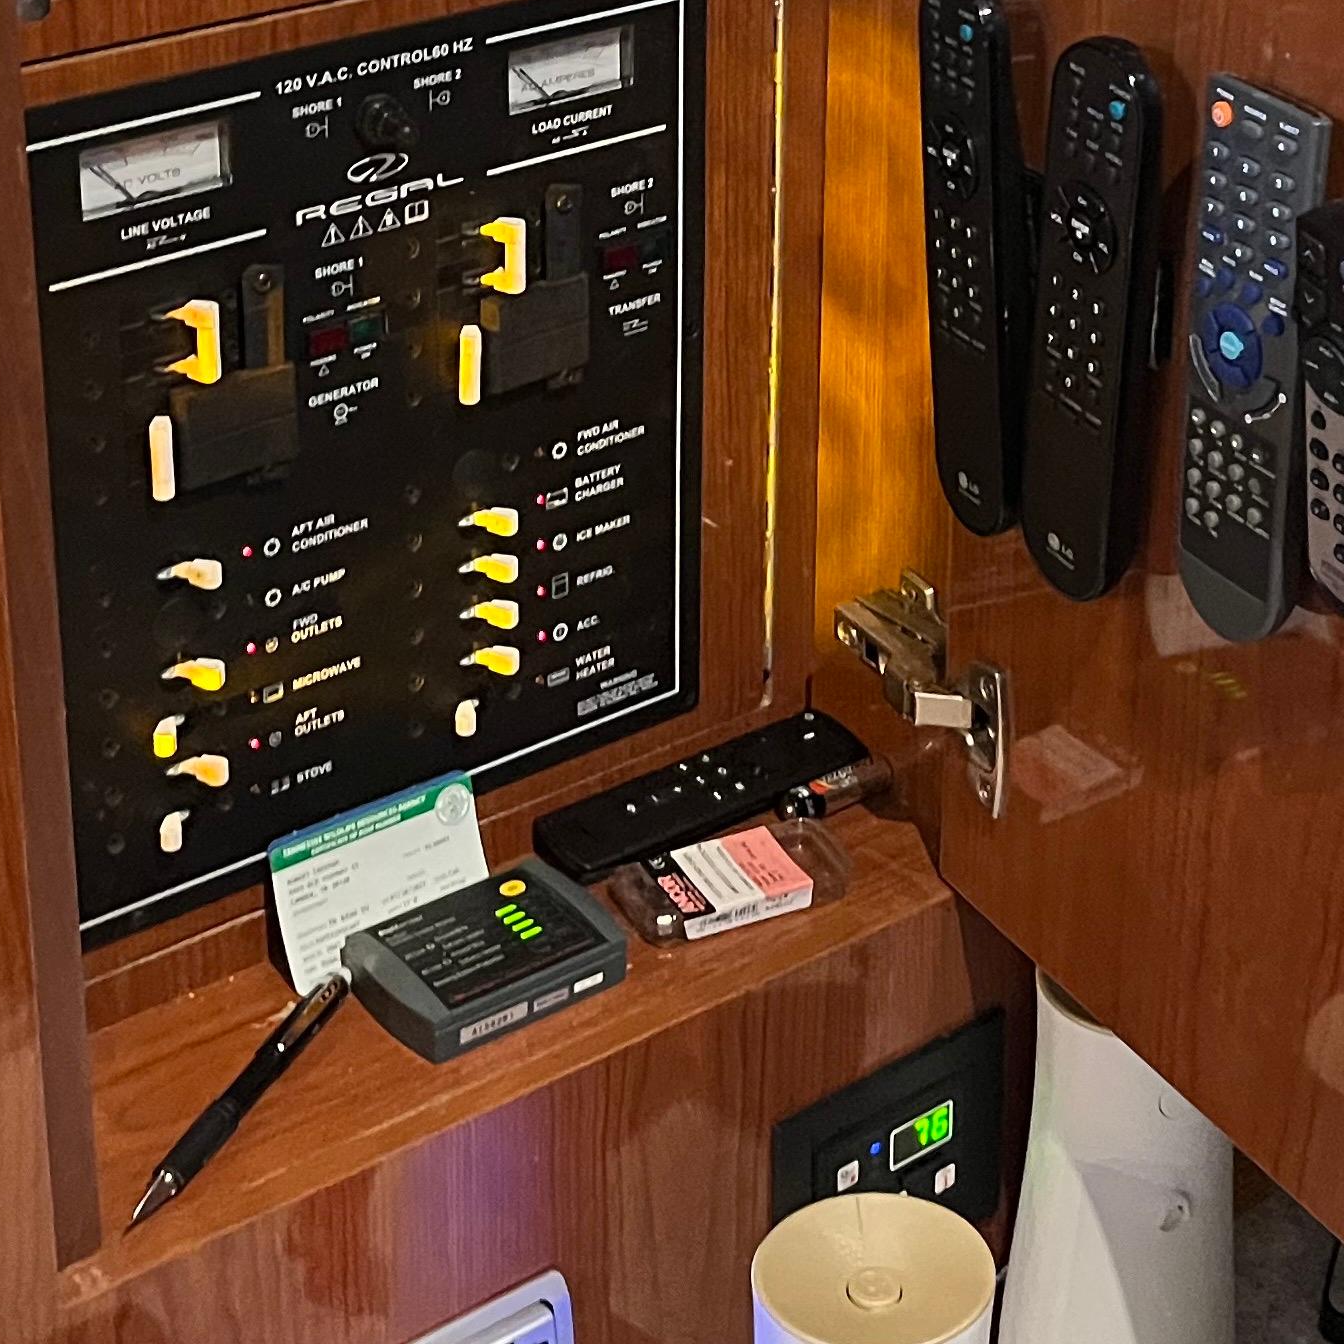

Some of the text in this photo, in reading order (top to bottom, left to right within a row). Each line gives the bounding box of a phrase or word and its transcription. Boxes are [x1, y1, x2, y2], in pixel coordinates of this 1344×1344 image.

[275, 77, 302, 96] 120
[305, 66, 353, 88] V.A.C.
[452, 37, 474, 54] HZ
[413, 68, 462, 90] SHORE 2
[292, 96, 342, 119] SHORE 1
[532, 104, 613, 135] LOAD CURRENT
[138, 167, 181, 186] VOLTS
[610, 179, 646, 198] SHORE
[295, 173, 464, 226] REGAL
[121, 206, 211, 241] LINE VOLTAGE
[315, 256, 363, 279] SHORE 1
[609, 293, 661, 316] TRANSFER
[308, 377, 379, 407] GENERATOR
[577, 419, 619, 442] FWD AIR
[577, 424, 645, 456] CONDITIONER
[575, 463, 622, 488] BATTERY
[575, 477, 624, 502] CHARGER
[291, 514, 335, 537] AFT AIR
[292, 518, 369, 553] CONDITIONER
[576, 514, 631, 543] ICE MAKER
[291, 568, 346, 596] A/C PUMP
[576, 565, 616, 587] REFRIG.
[291, 615, 343, 644] OUTLETS
[293, 613, 318, 631] FWD
[575, 645, 611, 667] WATER
[576, 657, 615, 680] HEATER
[292, 656, 361, 691] MICROWAVE
[294, 709, 345, 738] OUTLETS
[295, 707, 318, 726] AFT
[297, 759, 333, 784] STOVE
[913, 1106, 949, 1145] 76
